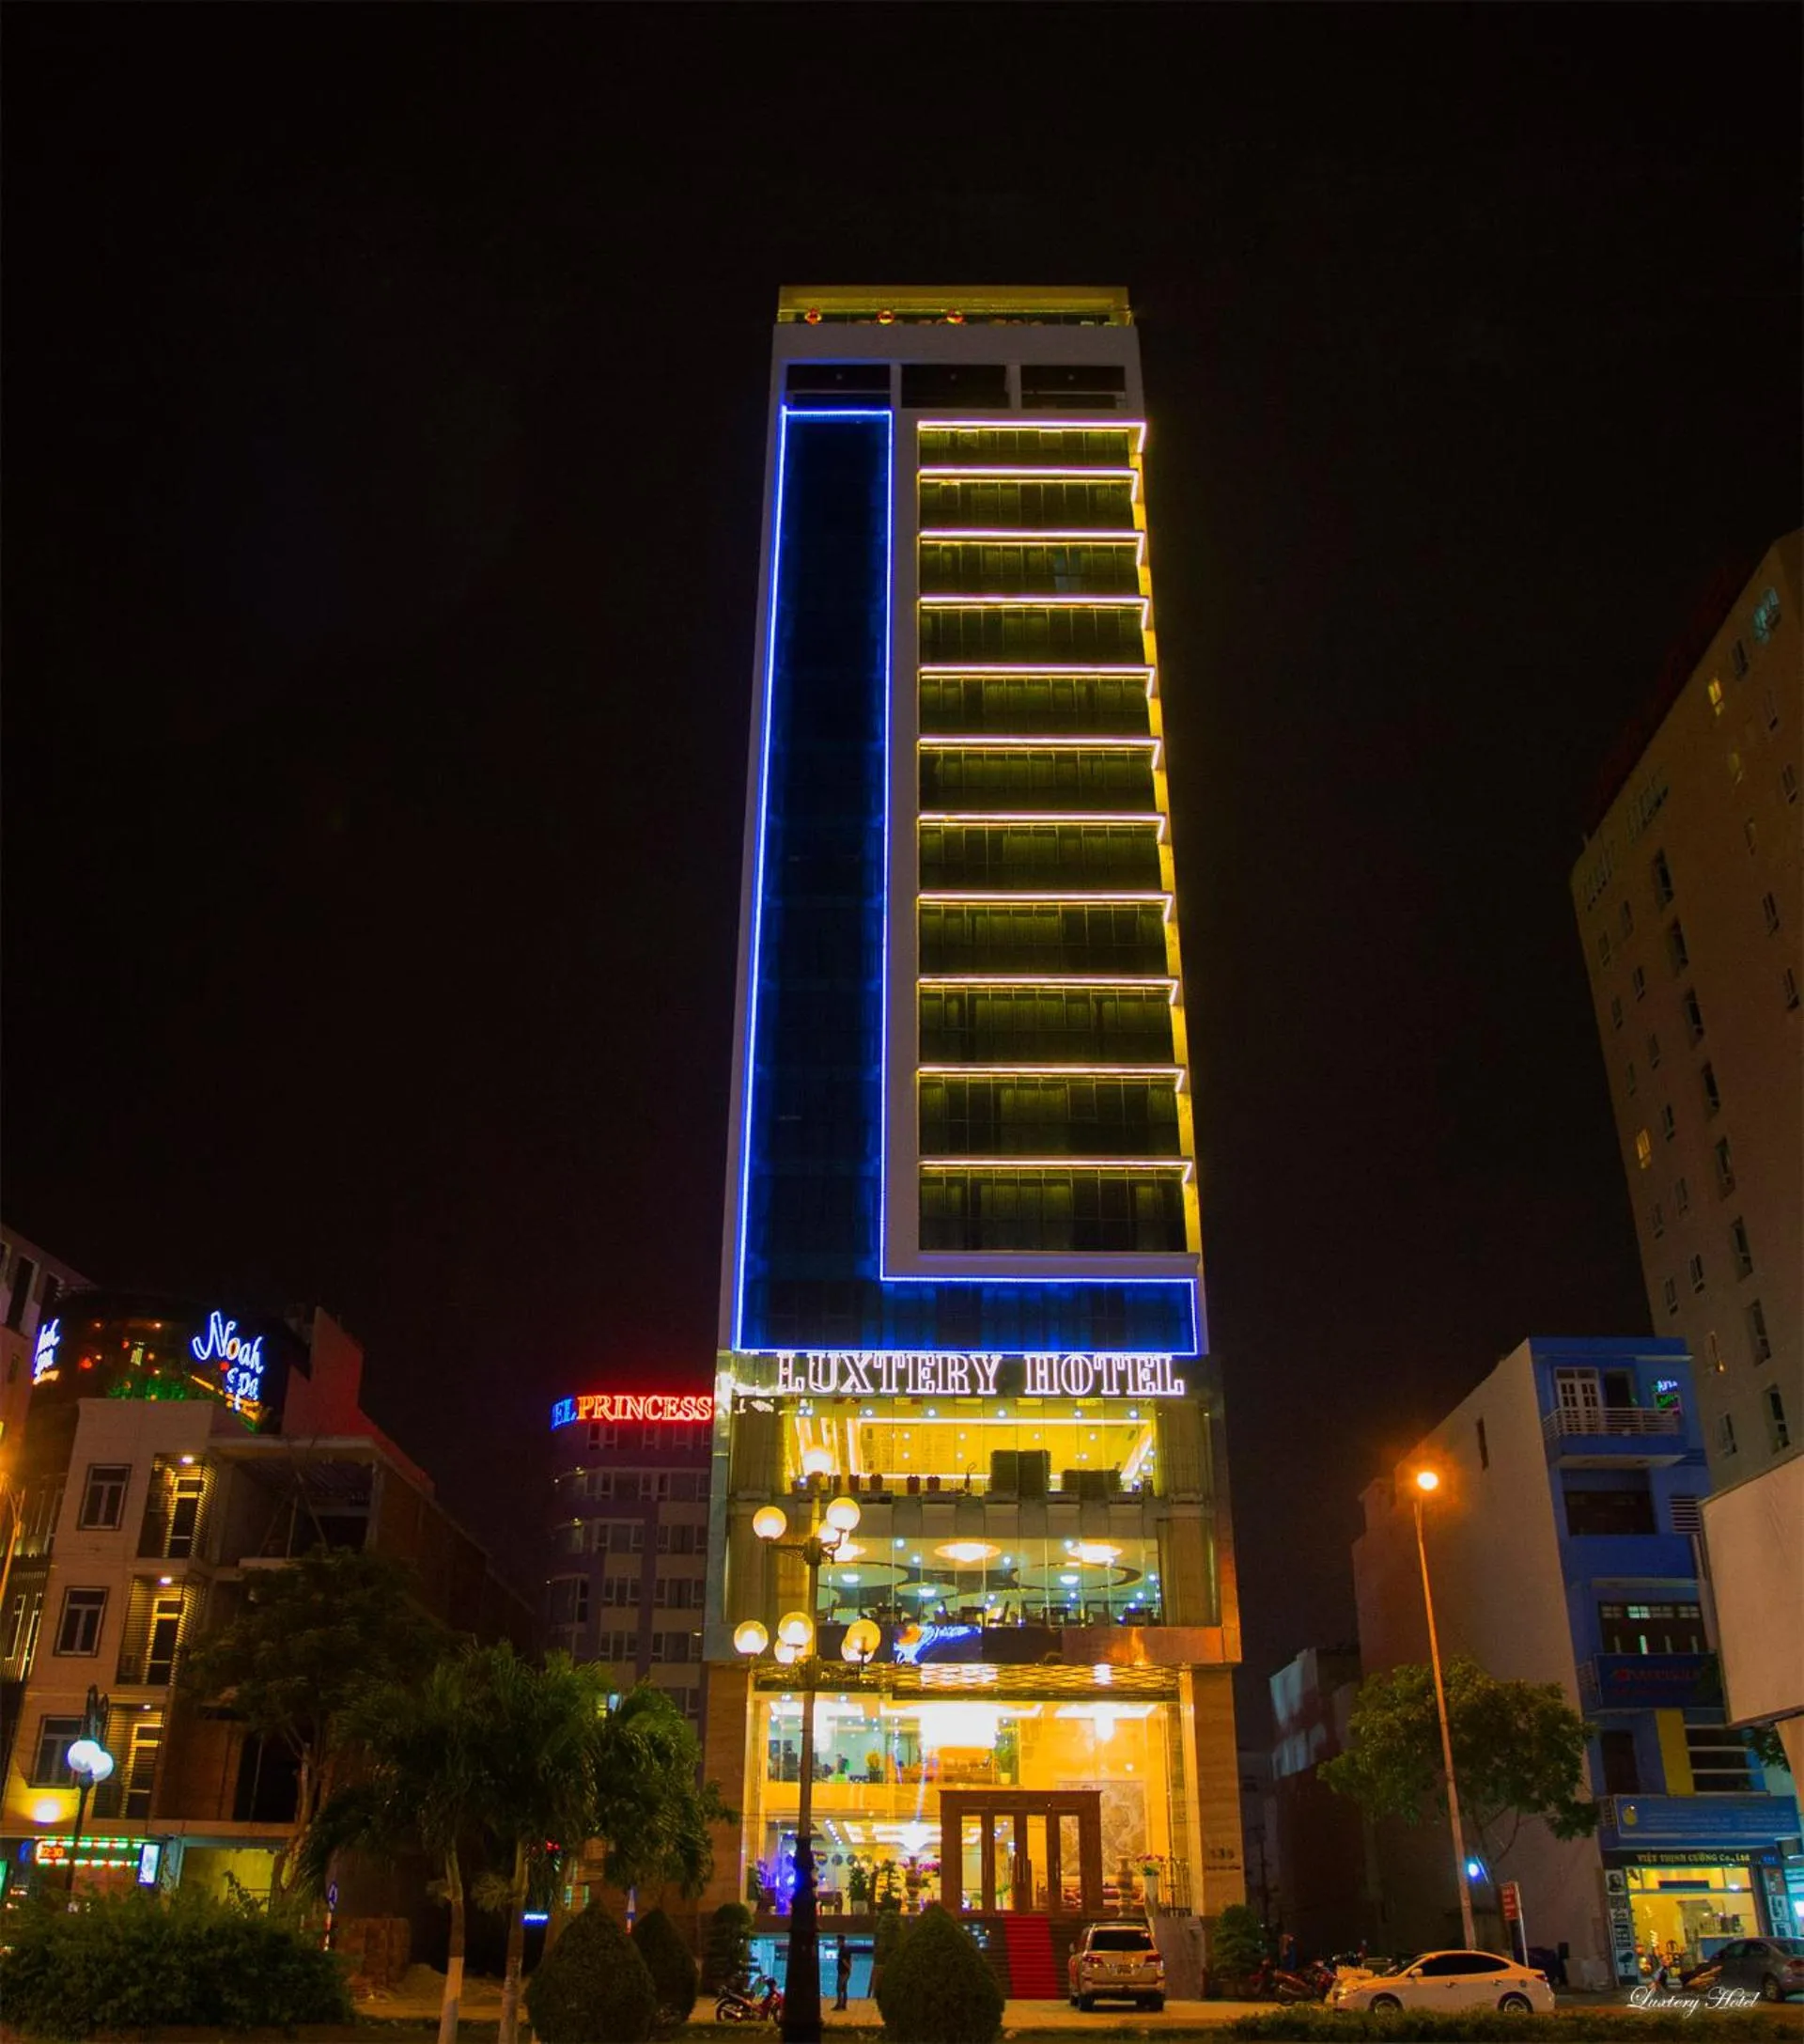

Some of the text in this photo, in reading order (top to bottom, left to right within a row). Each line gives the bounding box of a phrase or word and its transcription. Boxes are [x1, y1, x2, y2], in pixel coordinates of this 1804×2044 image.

[193, 1311, 264, 1374] Noah
[777, 1351, 1185, 1396] LUXTERY HOTEL
[576, 1395, 713, 1421] PRINCESS
